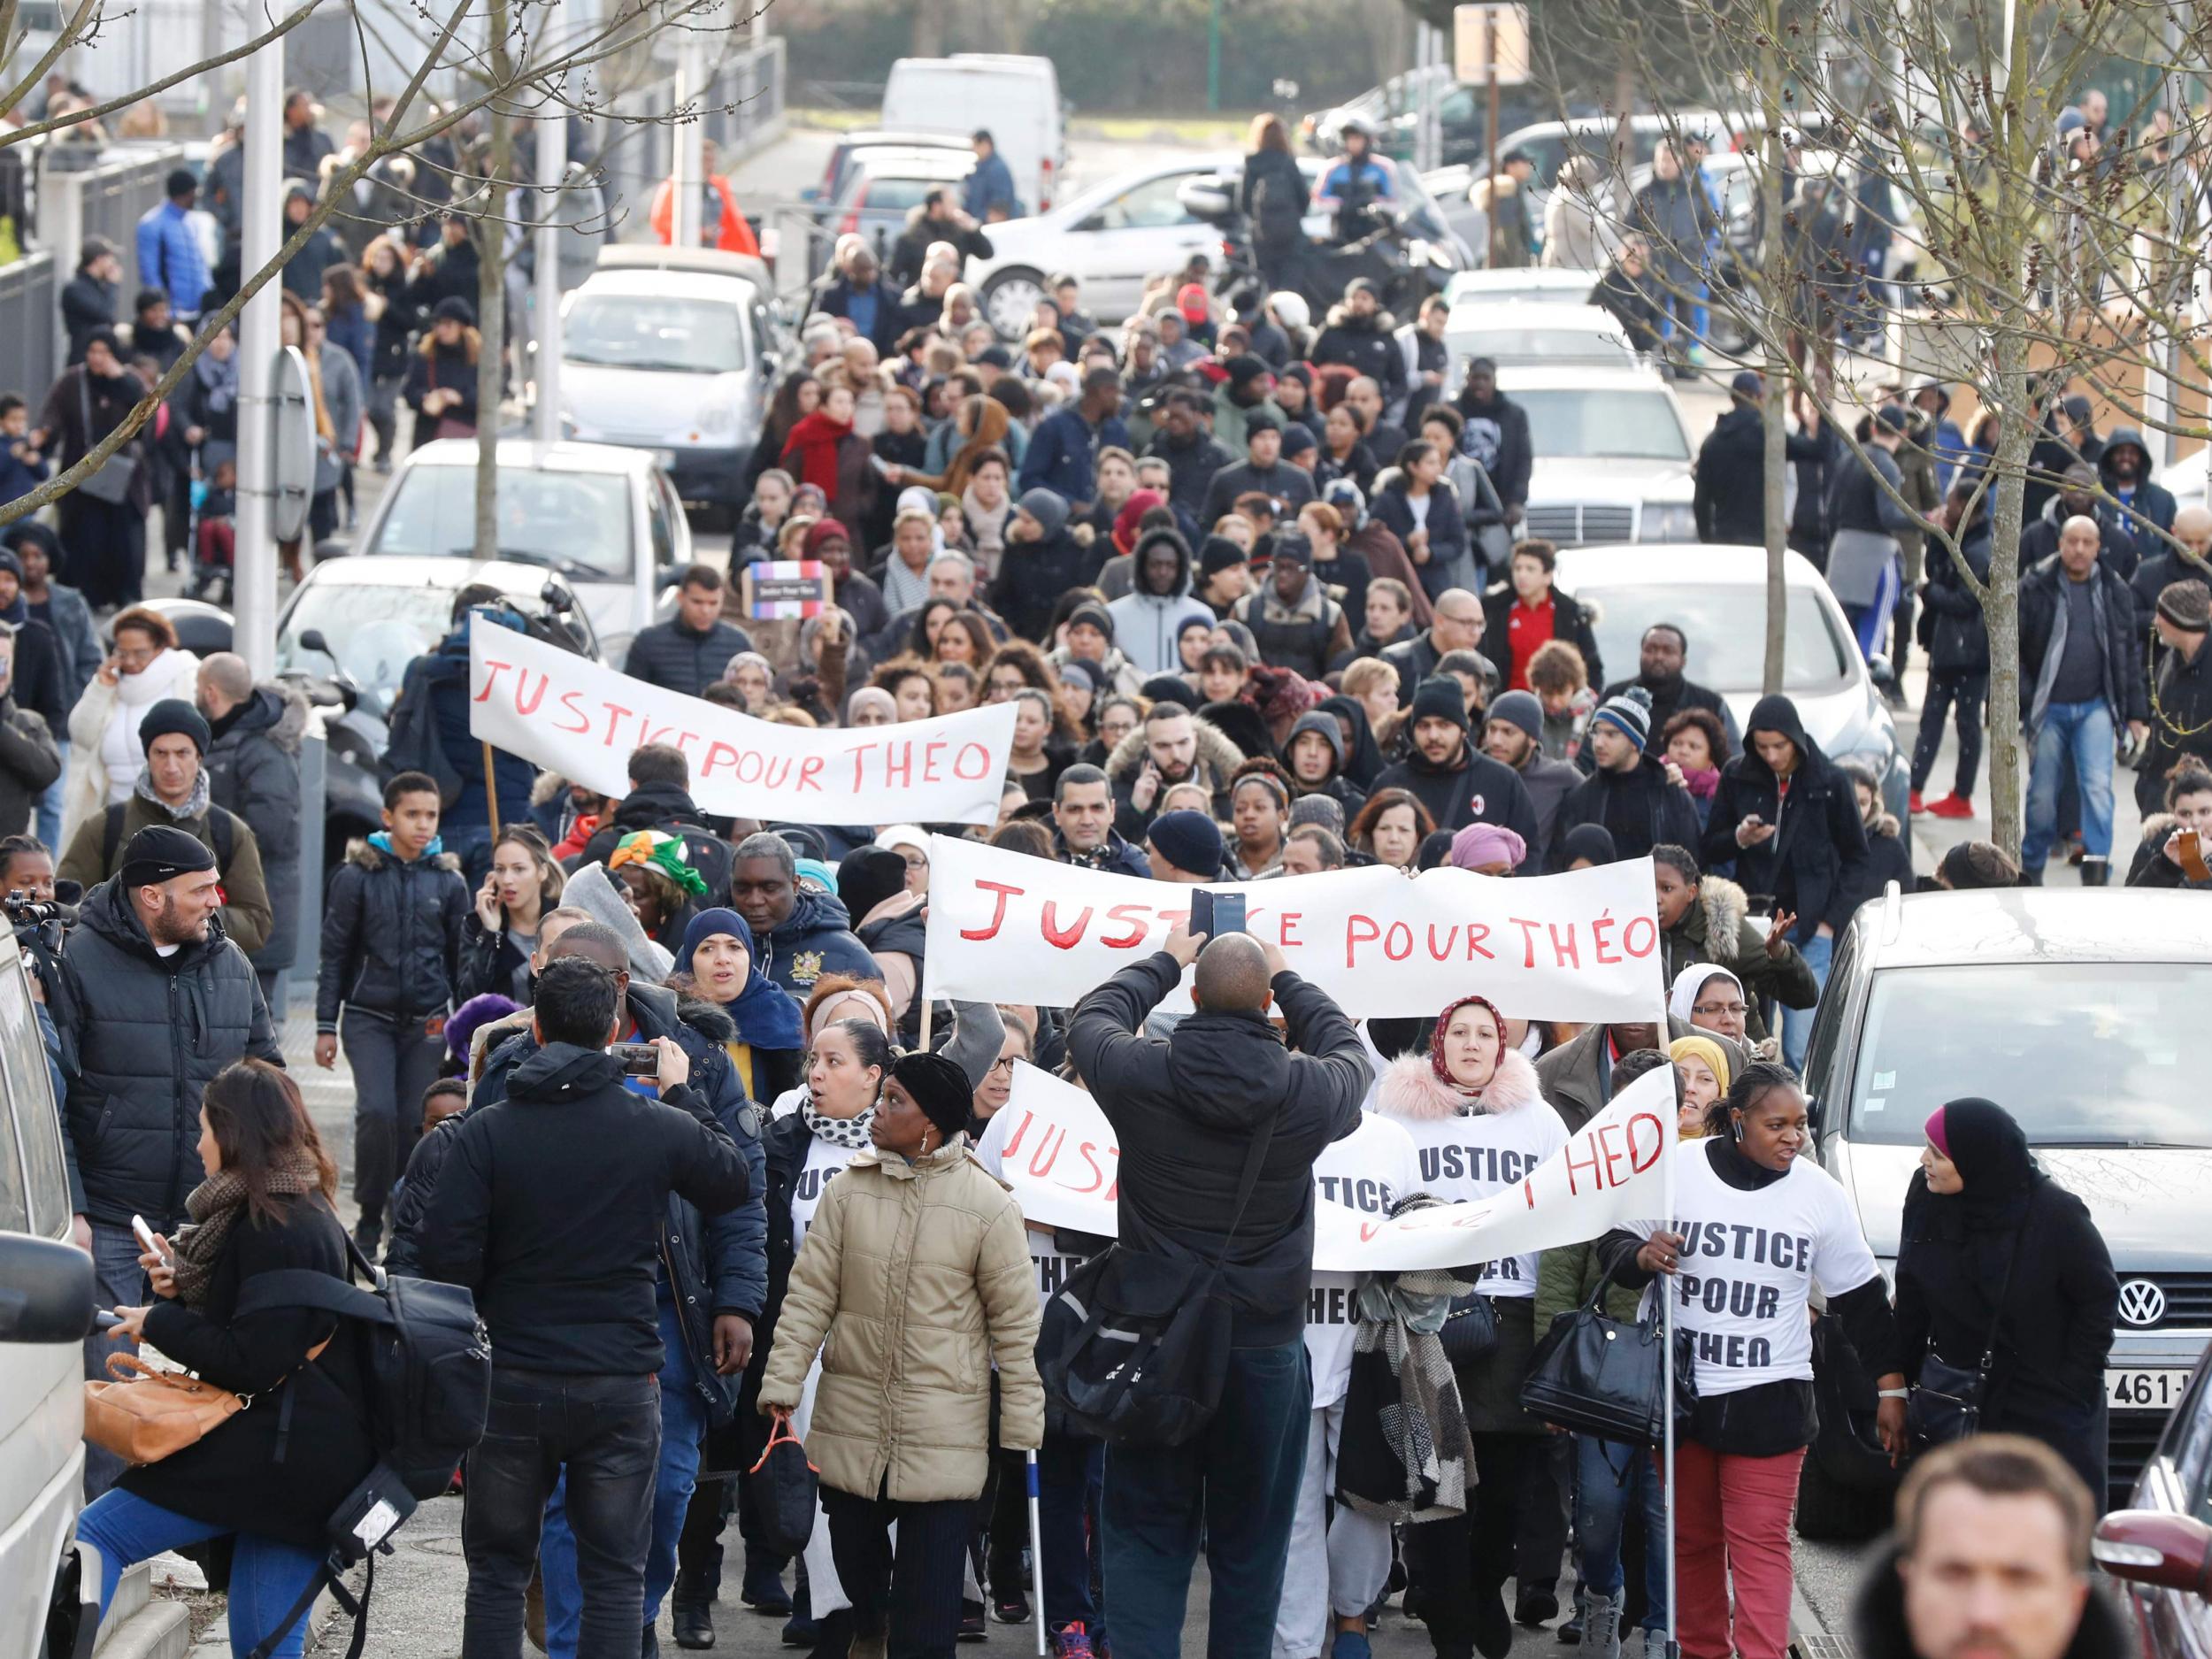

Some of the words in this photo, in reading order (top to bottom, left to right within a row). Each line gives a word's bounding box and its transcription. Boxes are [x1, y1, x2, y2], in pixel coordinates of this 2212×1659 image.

[701, 741, 823, 793] POUR
[843, 731, 991, 794] THÉO
[960, 879, 1303, 950] JUSE
[1347, 914, 1495, 969] POUR
[1509, 908, 1656, 970] THÉO
[1418, 1144, 1539, 1185] USTICE
[1319, 1176, 1394, 1215] TICE
[1673, 1220, 1810, 1273] USTICE
[1680, 1274, 1780, 1319] POUR
